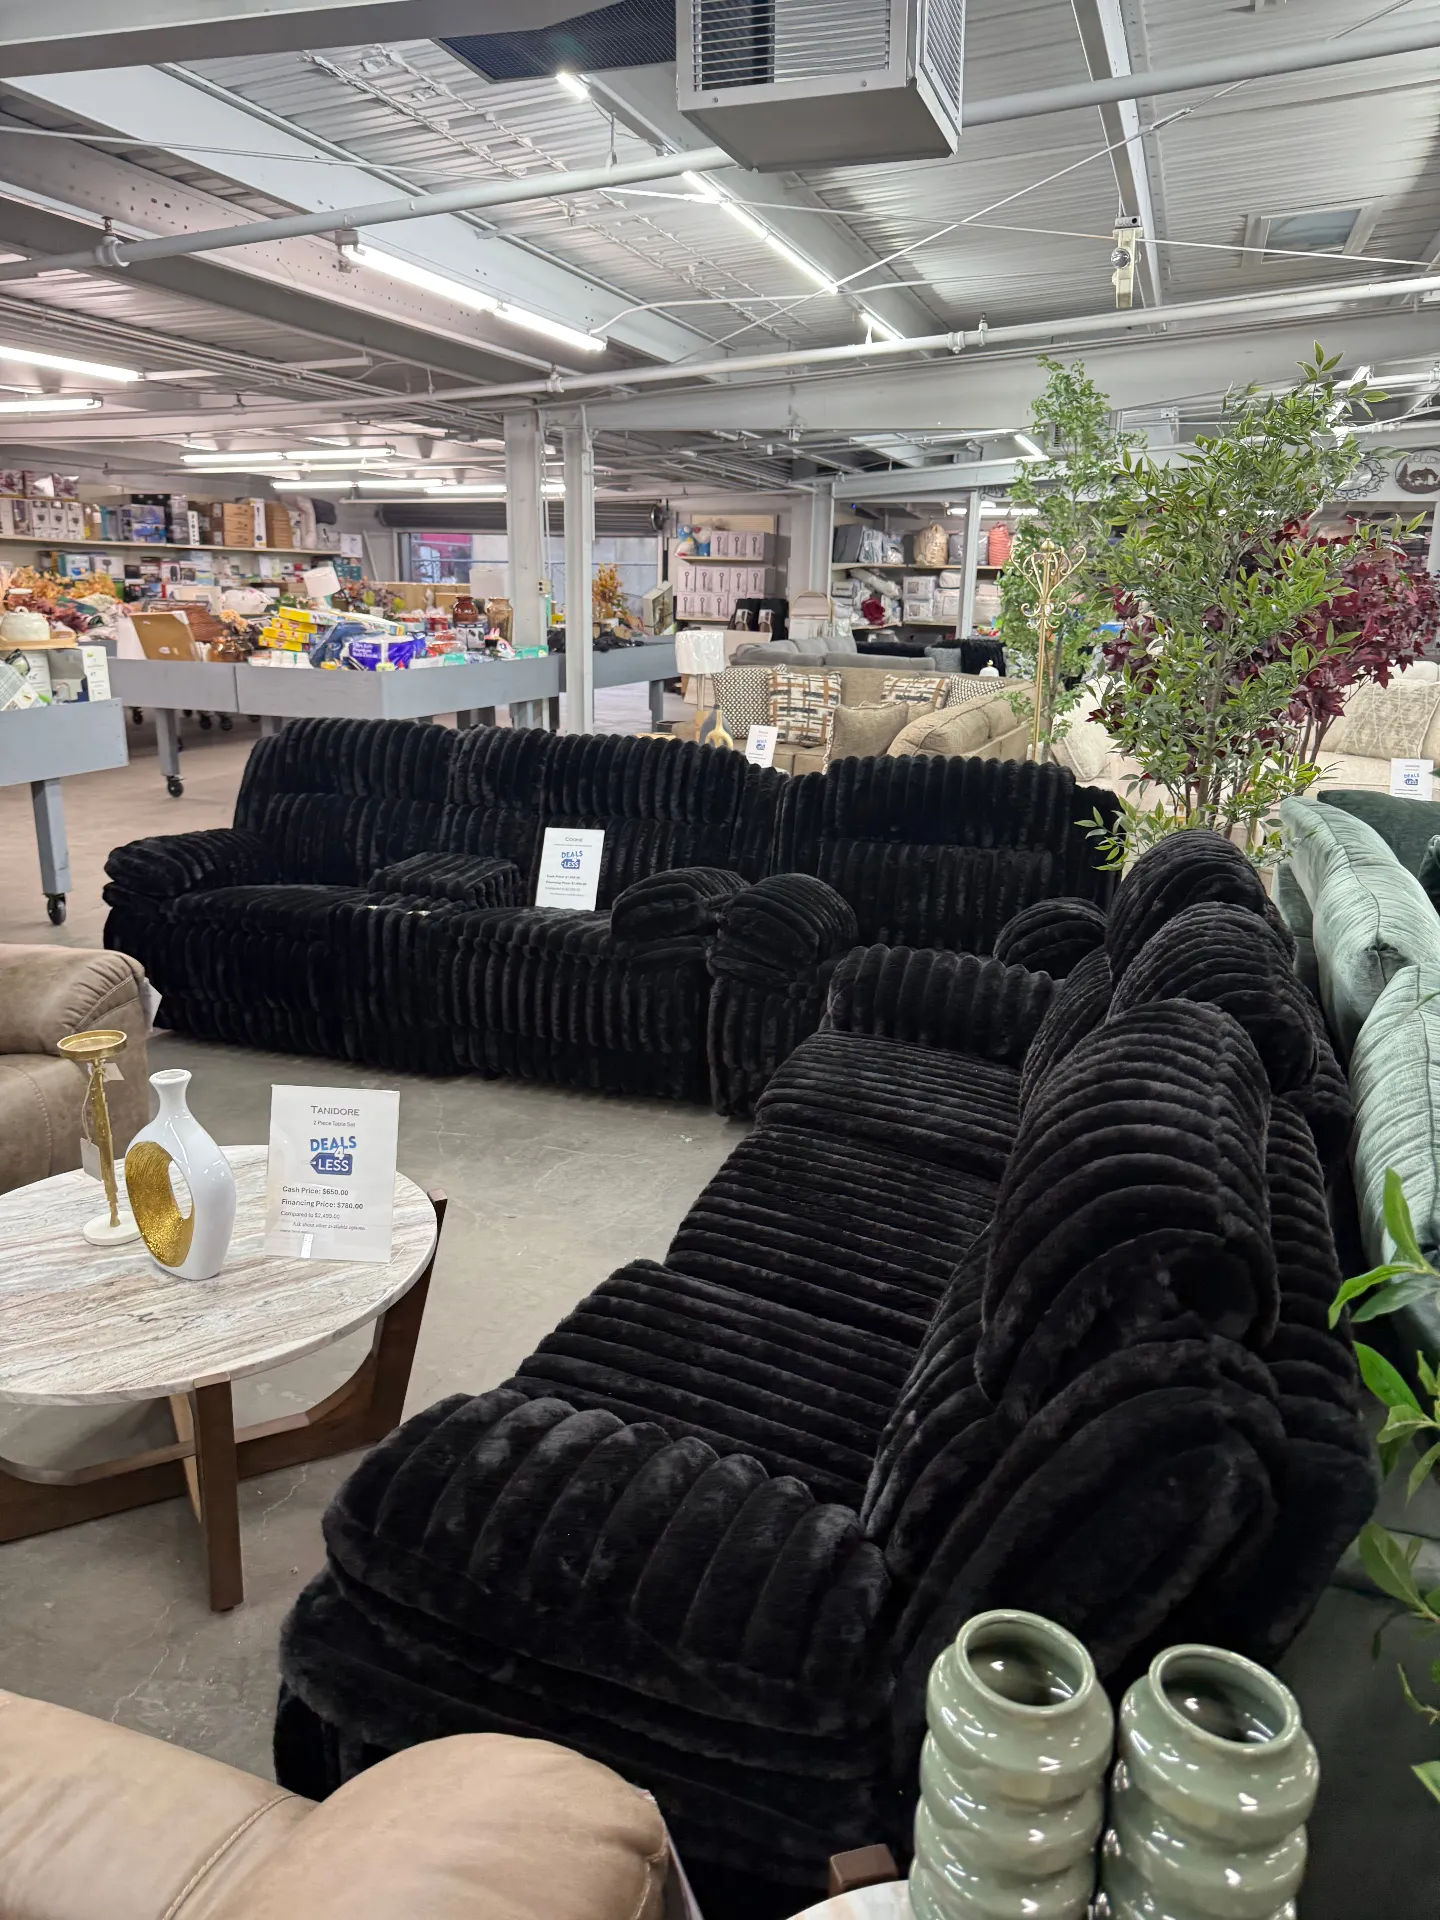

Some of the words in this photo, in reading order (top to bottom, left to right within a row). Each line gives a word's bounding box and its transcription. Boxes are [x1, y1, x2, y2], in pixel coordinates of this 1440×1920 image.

[561, 850, 583, 859] DEALS
[310, 1105, 360, 1116] TANIDORE
[310, 1135, 357, 1152] DEALS
[334, 1145, 345, 1160] 4
[318, 1158, 349, 1172] LESS
[282, 1185, 300, 1193] Cash
[322, 1188, 349, 1196] $650.00
[281, 1198, 314, 1208] Financing
[315, 1200, 336, 1208] Price:
[280, 1210, 307, 1218] Compared
